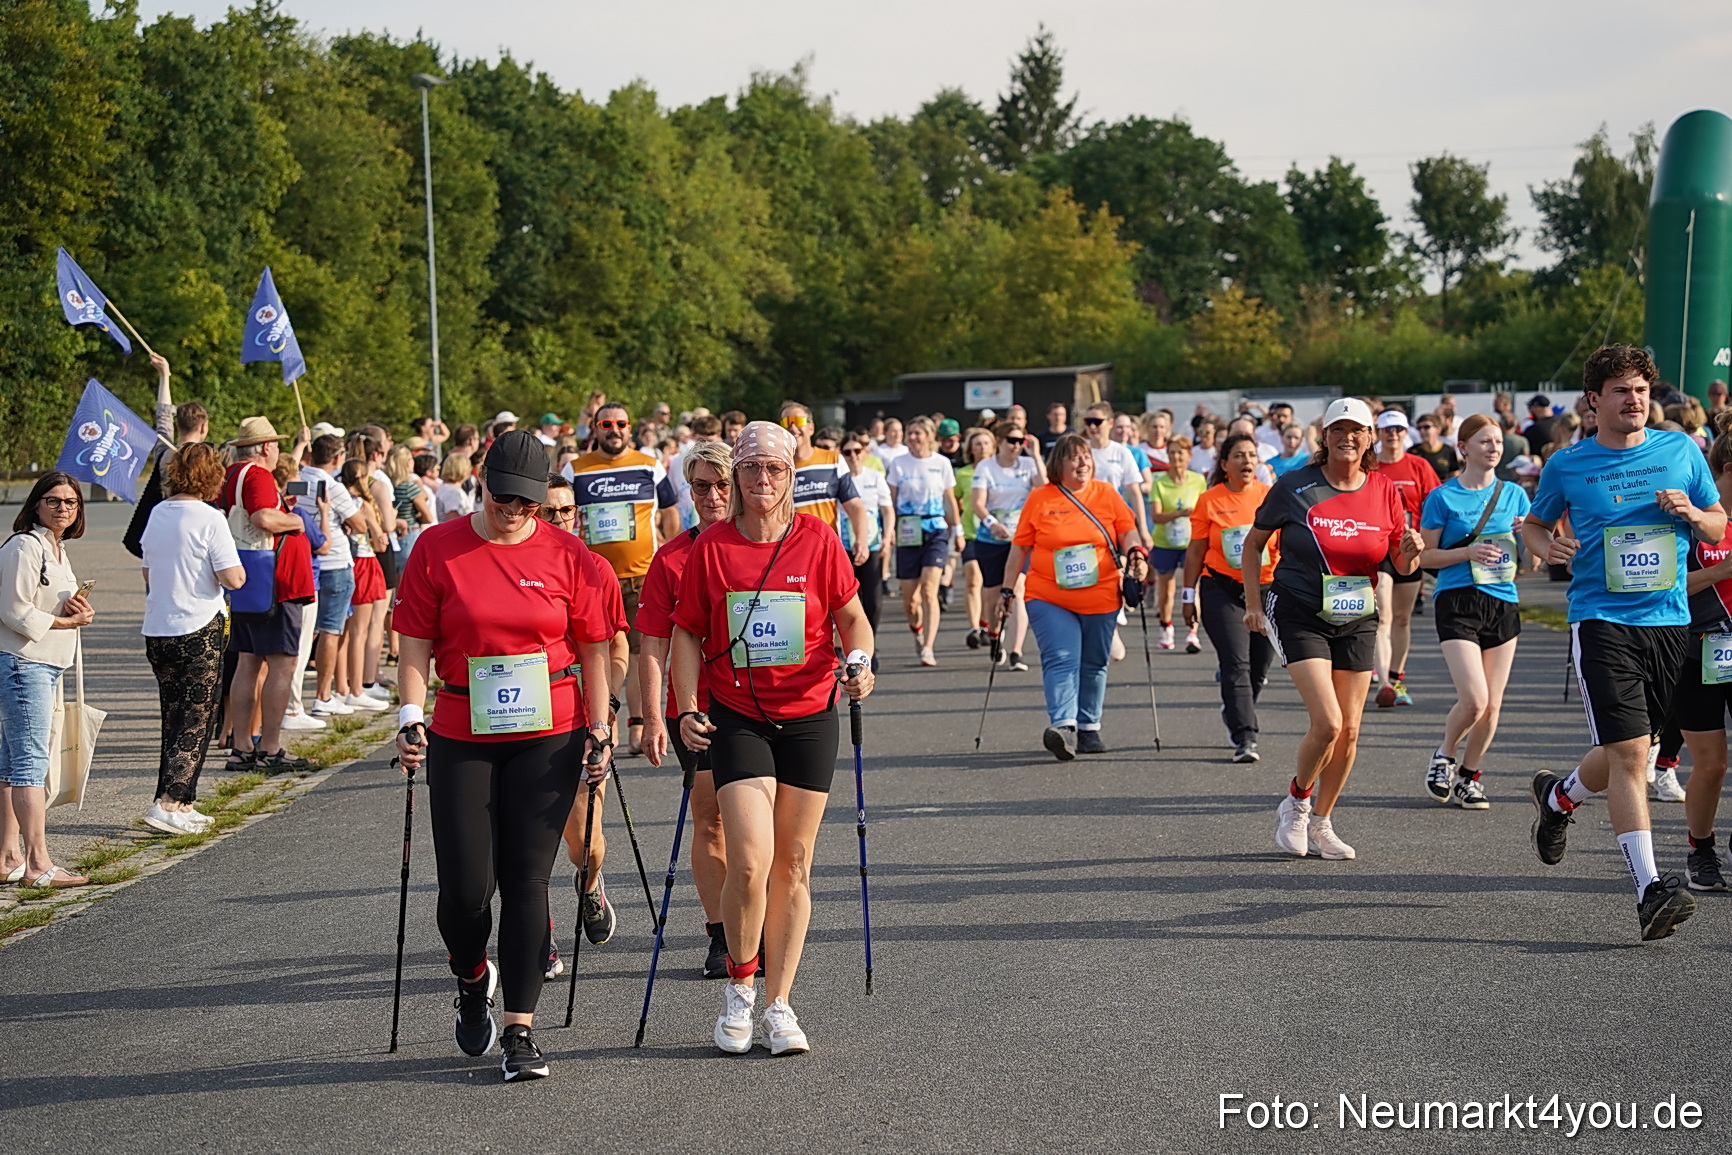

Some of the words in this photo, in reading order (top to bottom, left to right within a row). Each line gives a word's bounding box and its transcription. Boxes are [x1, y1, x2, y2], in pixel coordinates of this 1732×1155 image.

[1585, 475, 1599, 485] Wir
[1600, 472, 1624, 482] halten
[1625, 464, 1668, 478] Immobilien
[597, 482, 642, 493] Fischer
[794, 480, 829, 493] ischer
[1608, 484, 1620, 492] am
[1621, 480, 1650, 490] Laufen.
[598, 519, 618, 528] 888
[1619, 553, 1660, 567] 1203
[1065, 562, 1087, 574] 936
[519, 578, 545, 588] Sarah
[786, 575, 807, 583] Moni
[1332, 599, 1365, 610] 2068
[752, 622, 777, 637] 64
[497, 688, 521, 704] 67
[508, 706, 536, 715] Nehring
